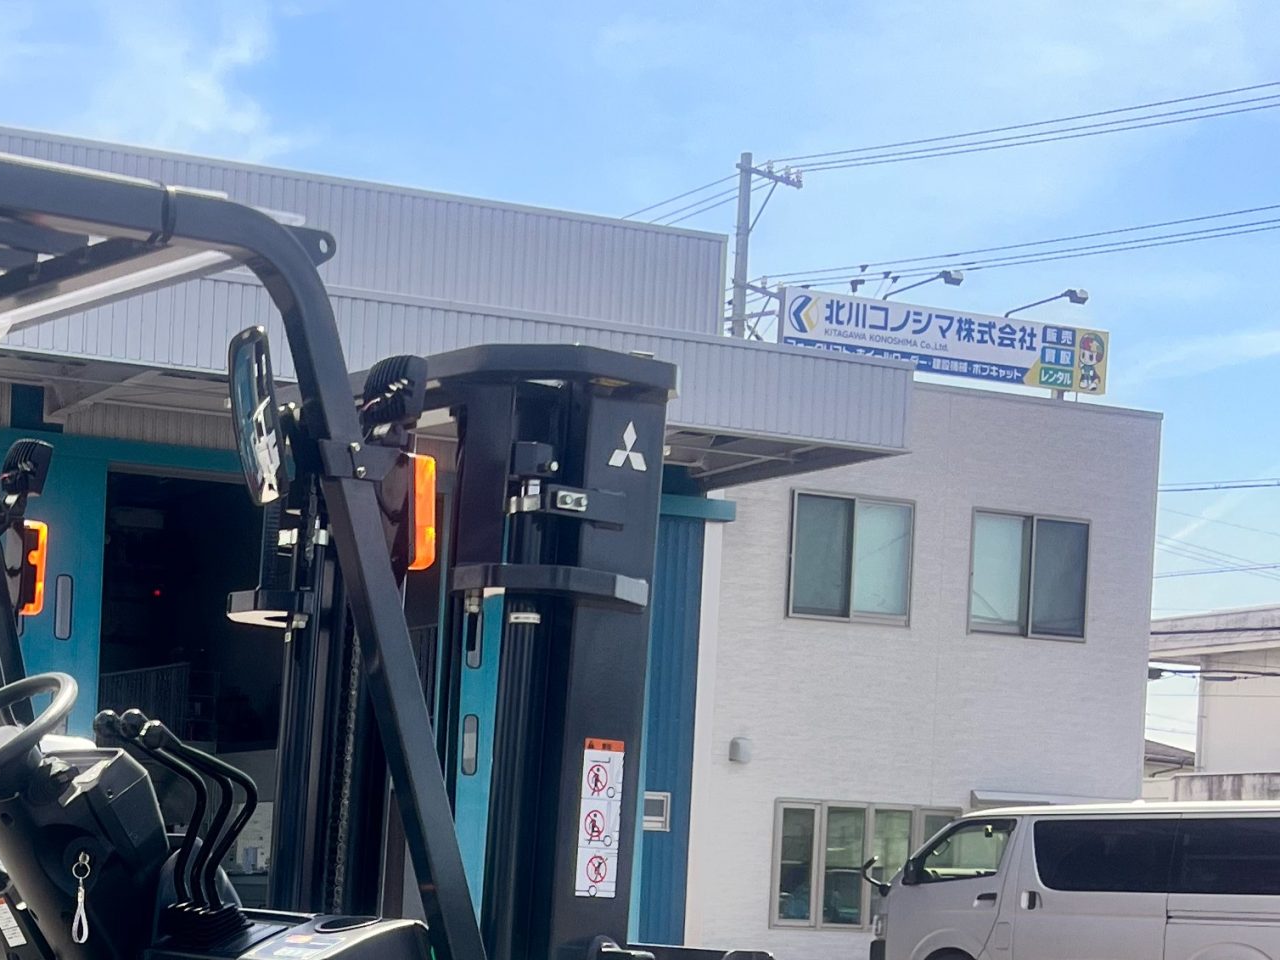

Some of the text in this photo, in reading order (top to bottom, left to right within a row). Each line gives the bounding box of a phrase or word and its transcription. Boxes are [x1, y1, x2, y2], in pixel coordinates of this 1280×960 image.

[824, 299, 1037, 351] 北川コノシマ株式会社
[824, 328, 867, 341] KITAGAWA
[869, 333, 918, 348] KONOSHIMA
[1041, 369, 1072, 385] レンタル
